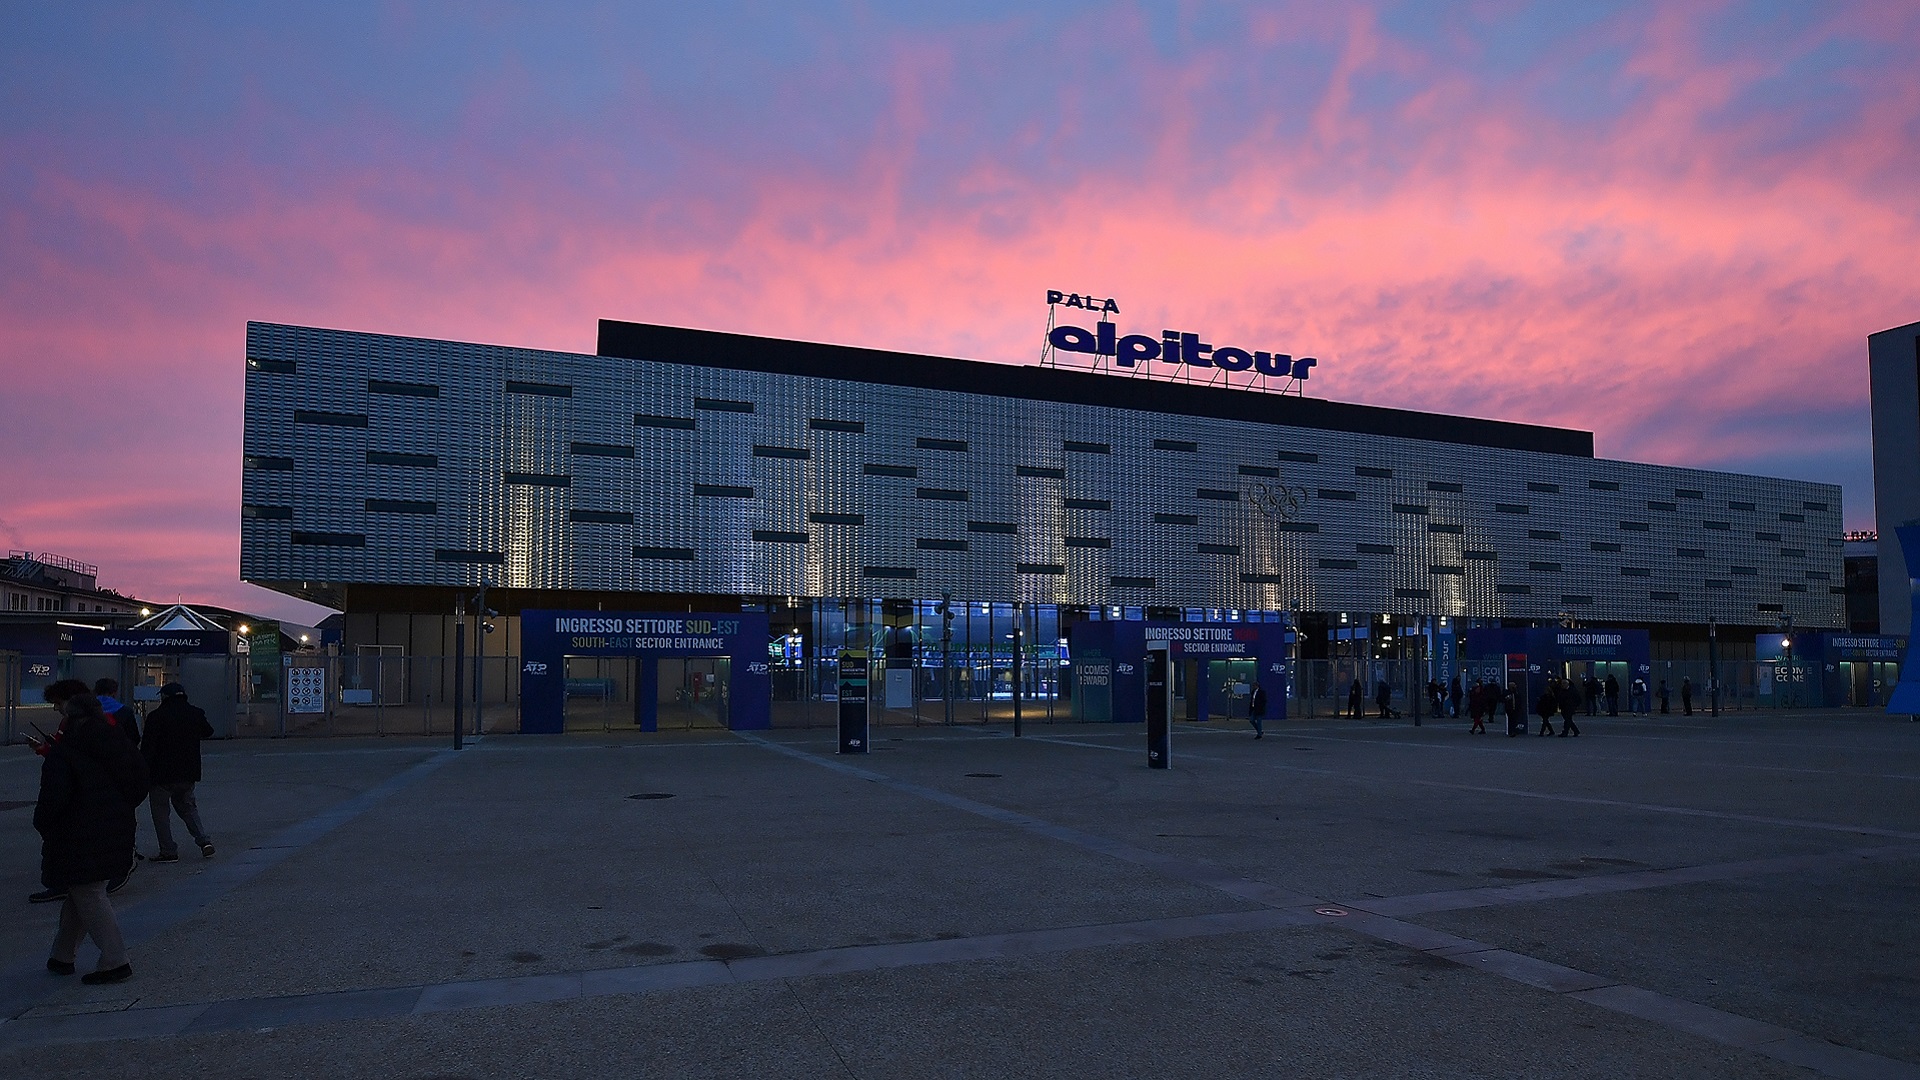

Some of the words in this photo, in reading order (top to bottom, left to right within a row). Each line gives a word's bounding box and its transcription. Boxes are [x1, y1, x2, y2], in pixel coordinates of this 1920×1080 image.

[1047, 290, 1120, 314] PALA
[1048, 322, 1317, 379] alpitour
[556, 618, 622, 633] INGRESSO
[626, 619, 682, 634] SETTORE
[686, 620, 739, 635] SUD-EST
[1145, 627, 1191, 640] INGRESSO
[1193, 627, 1232, 640] SETTORE
[1557, 633, 1590, 645] INGRESSO
[1592, 634, 1622, 645] PARTNER
[102, 637, 139, 646] Nitto
[165, 638, 201, 647] FINALS
[571, 636, 632, 648] SOUTH-EAST
[635, 637, 672, 649] SECTOR
[674, 637, 724, 649] ENTRANCE
[1183, 642, 1210, 653] SECTOR
[1211, 642, 1246, 653] ENTRANCE
[523, 663, 548, 672] ATP
[746, 664, 768, 673] ATP
[1116, 664, 1134, 672] ATP
